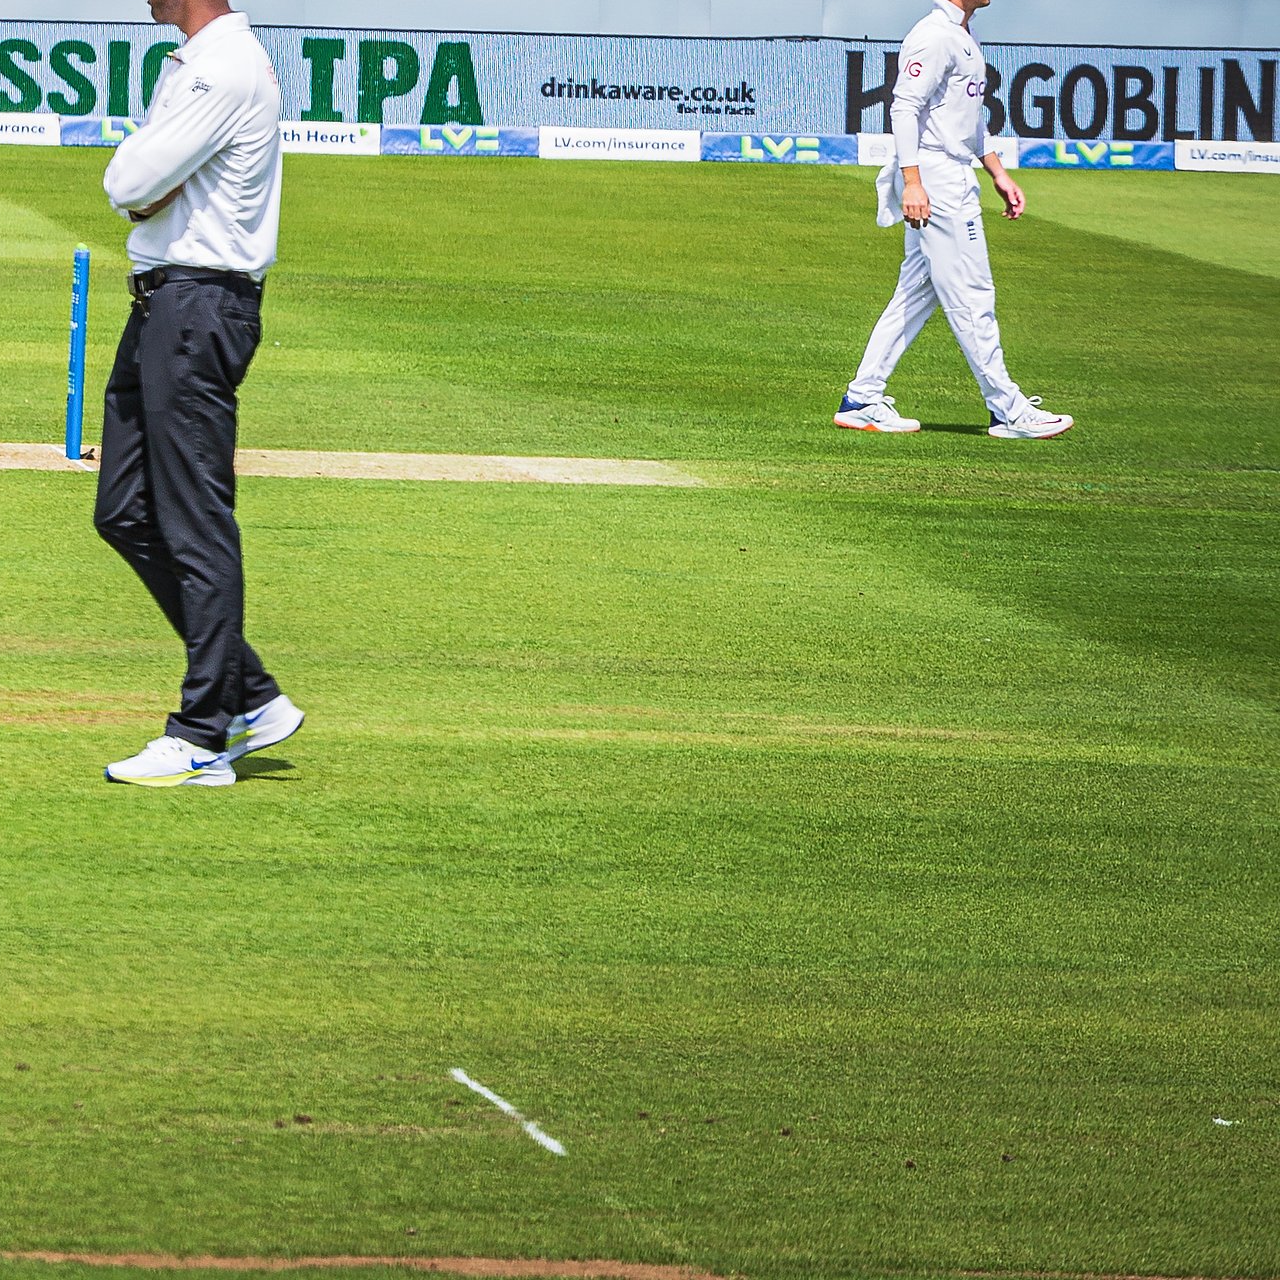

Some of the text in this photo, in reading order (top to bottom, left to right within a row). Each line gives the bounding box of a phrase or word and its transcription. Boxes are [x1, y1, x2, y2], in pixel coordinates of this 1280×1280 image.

[301, 37, 484, 126] IPA
[541, 77, 756, 104] drinkaware.co.uk
[306, 129, 356, 144] Heart
[553, 137, 686, 152] LV.com/insurance
